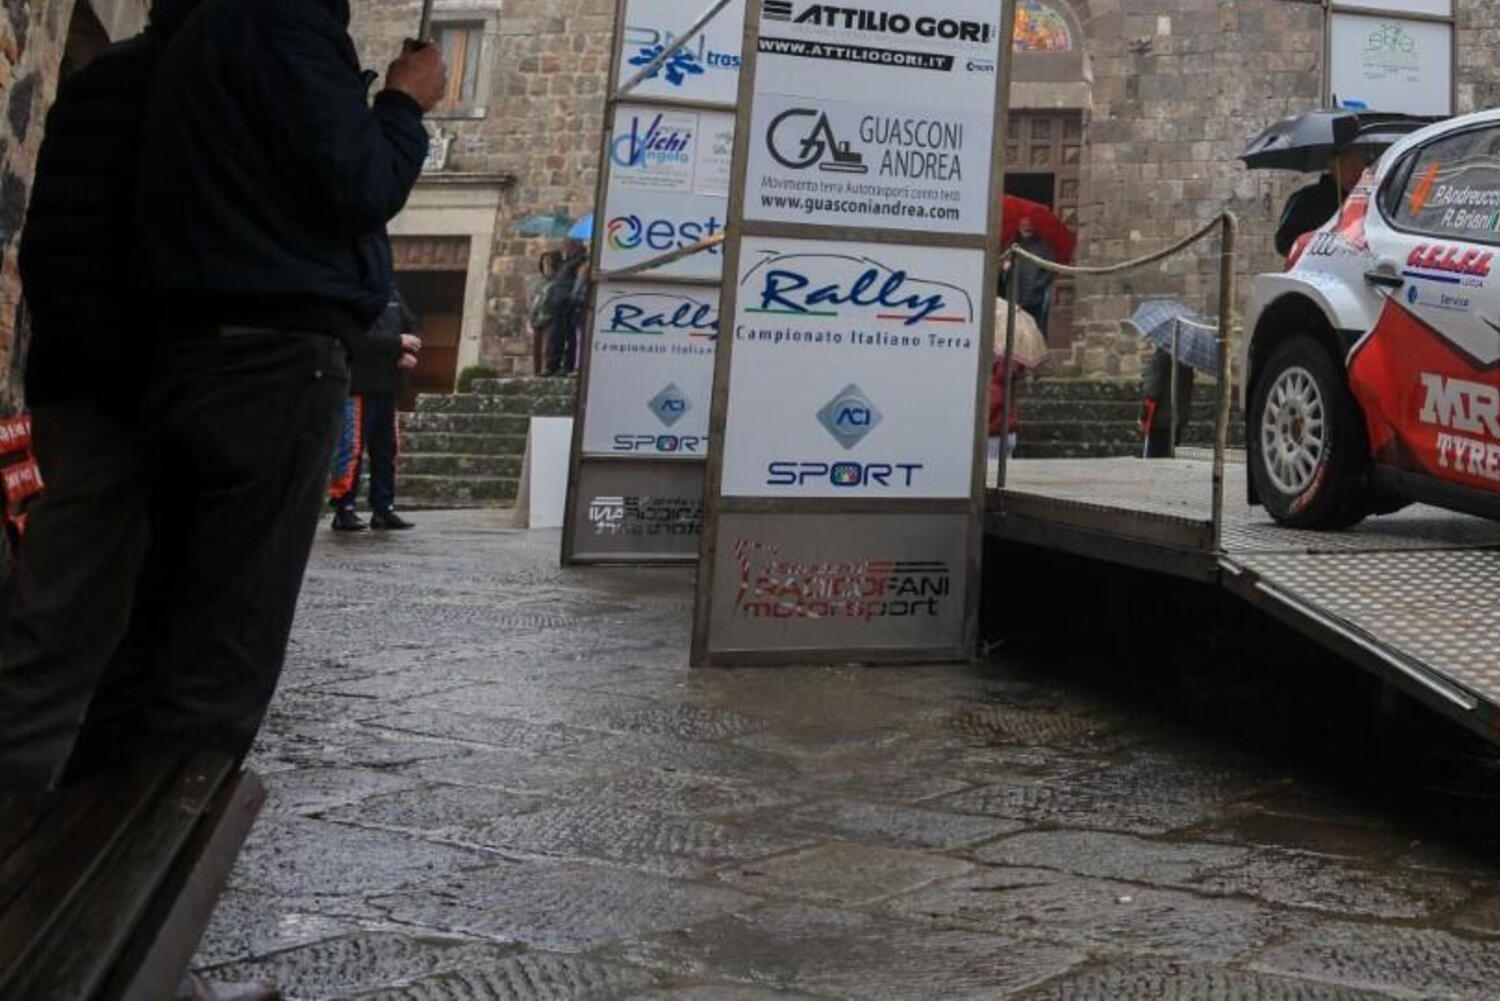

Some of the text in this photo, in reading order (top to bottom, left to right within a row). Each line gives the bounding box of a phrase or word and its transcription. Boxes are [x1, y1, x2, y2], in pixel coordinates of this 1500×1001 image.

[792, 3, 912, 34] ATTILIO
[914, 16, 992, 44] GORI
[758, 39, 946, 69] WWW.ATTILIOGORI.IT
[859, 115, 963, 150] GUASCONI
[879, 149, 962, 181] ANDREA
[760, 194, 960, 220] www.guasconiandrea.com
[760, 268, 946, 326] Rally
[735, 325, 972, 349] Campionato Italiano Terra
[836, 406, 870, 426] ACI
[766, 460, 924, 487] SPORT
